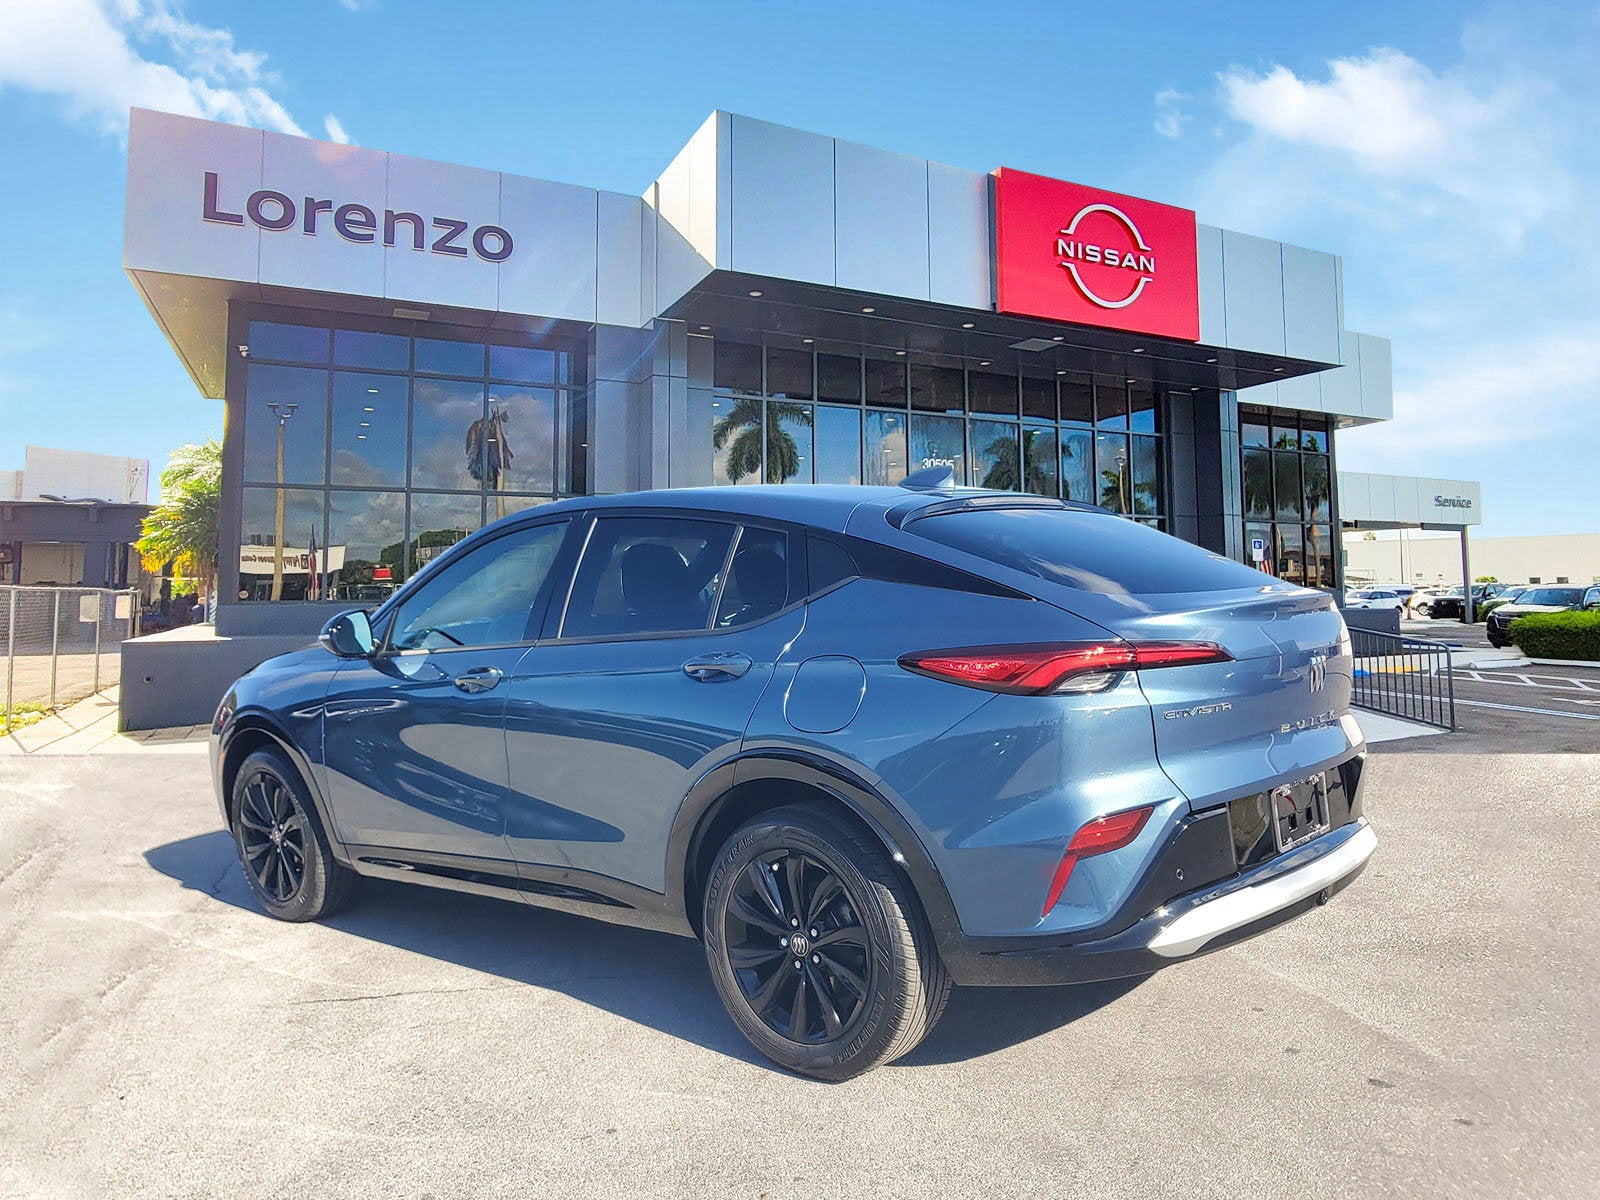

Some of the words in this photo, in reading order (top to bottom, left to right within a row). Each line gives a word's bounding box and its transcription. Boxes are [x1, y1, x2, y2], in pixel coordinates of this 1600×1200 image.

[202, 170, 514, 262] Lorenzo
[1057, 238, 1155, 273] NISSAN
[1434, 495, 1472, 509] Service
[1164, 702, 1232, 720] ENVISTA
[1281, 709, 1335, 733] BUICK
